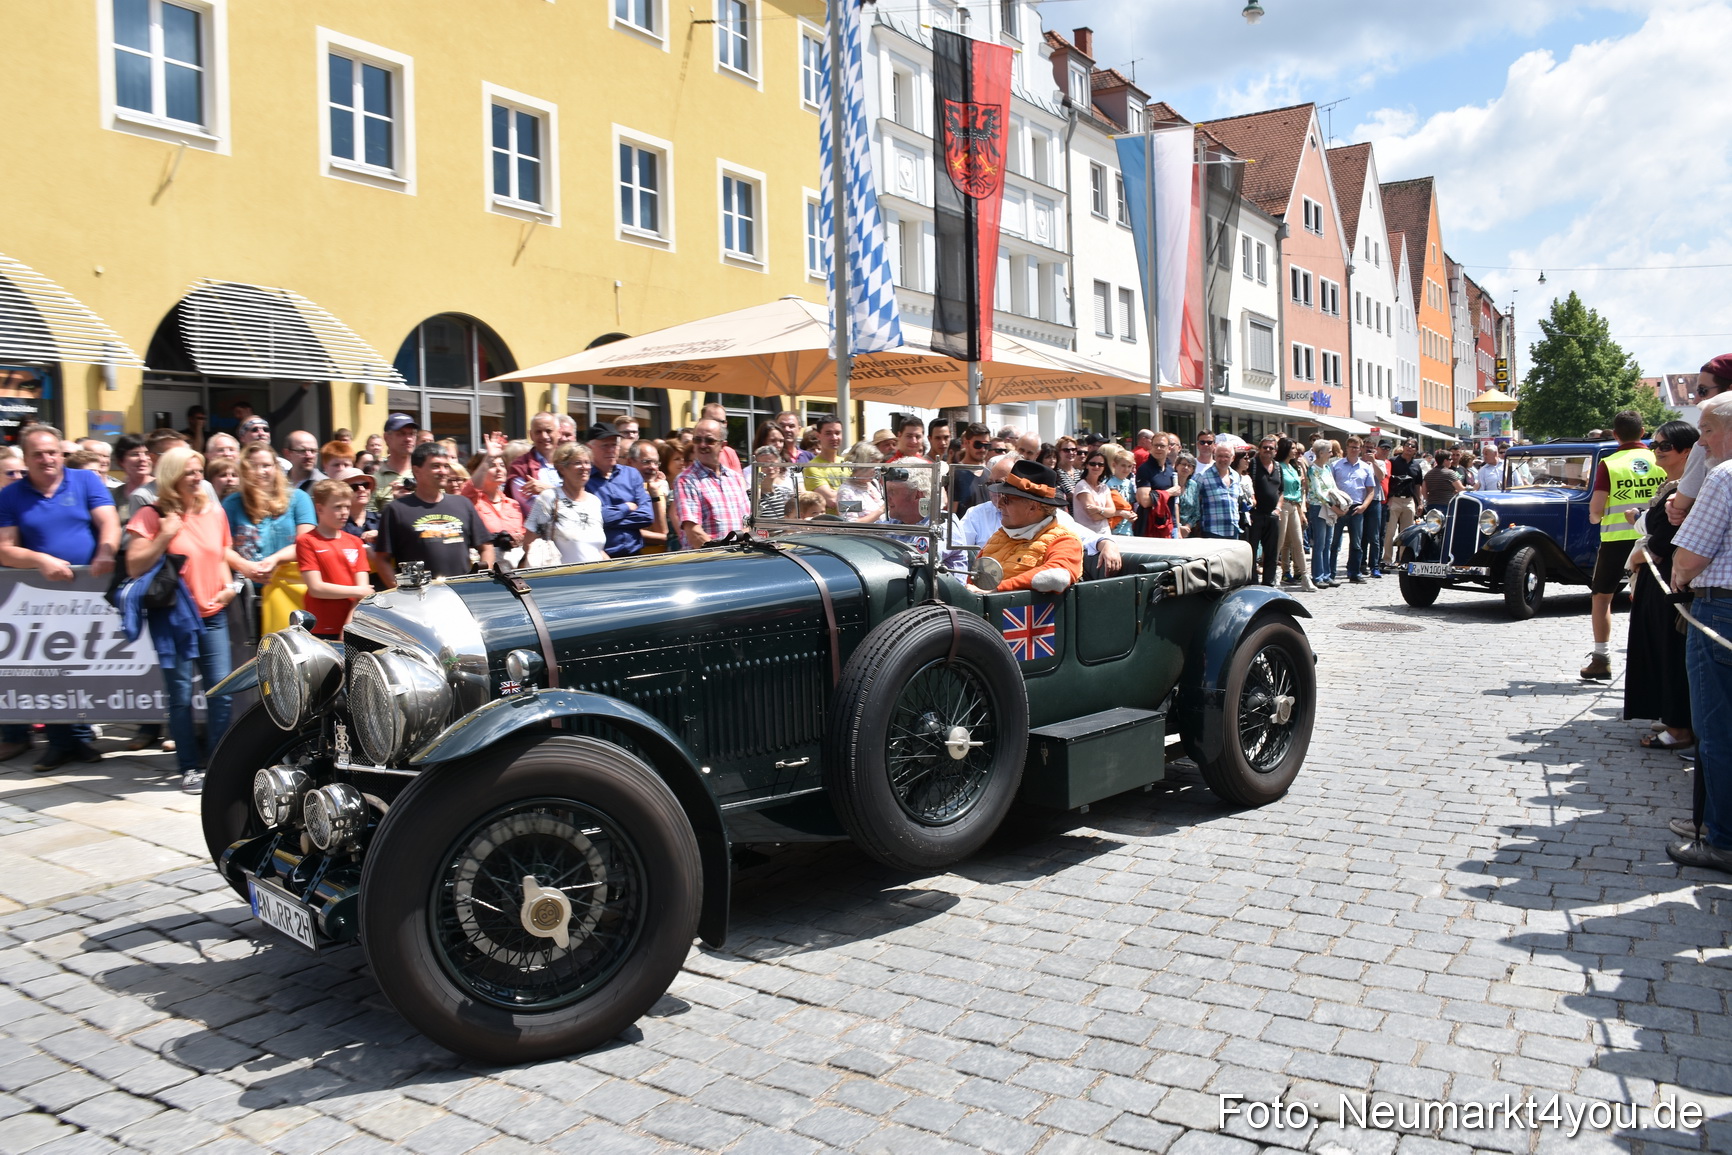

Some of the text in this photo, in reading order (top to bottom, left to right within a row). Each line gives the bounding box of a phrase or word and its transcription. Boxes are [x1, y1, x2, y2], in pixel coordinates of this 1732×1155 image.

[1617, 476, 1667, 489] FOLLOW
[1634, 489, 1652, 498] ME
[276, 901, 294, 934] RR
